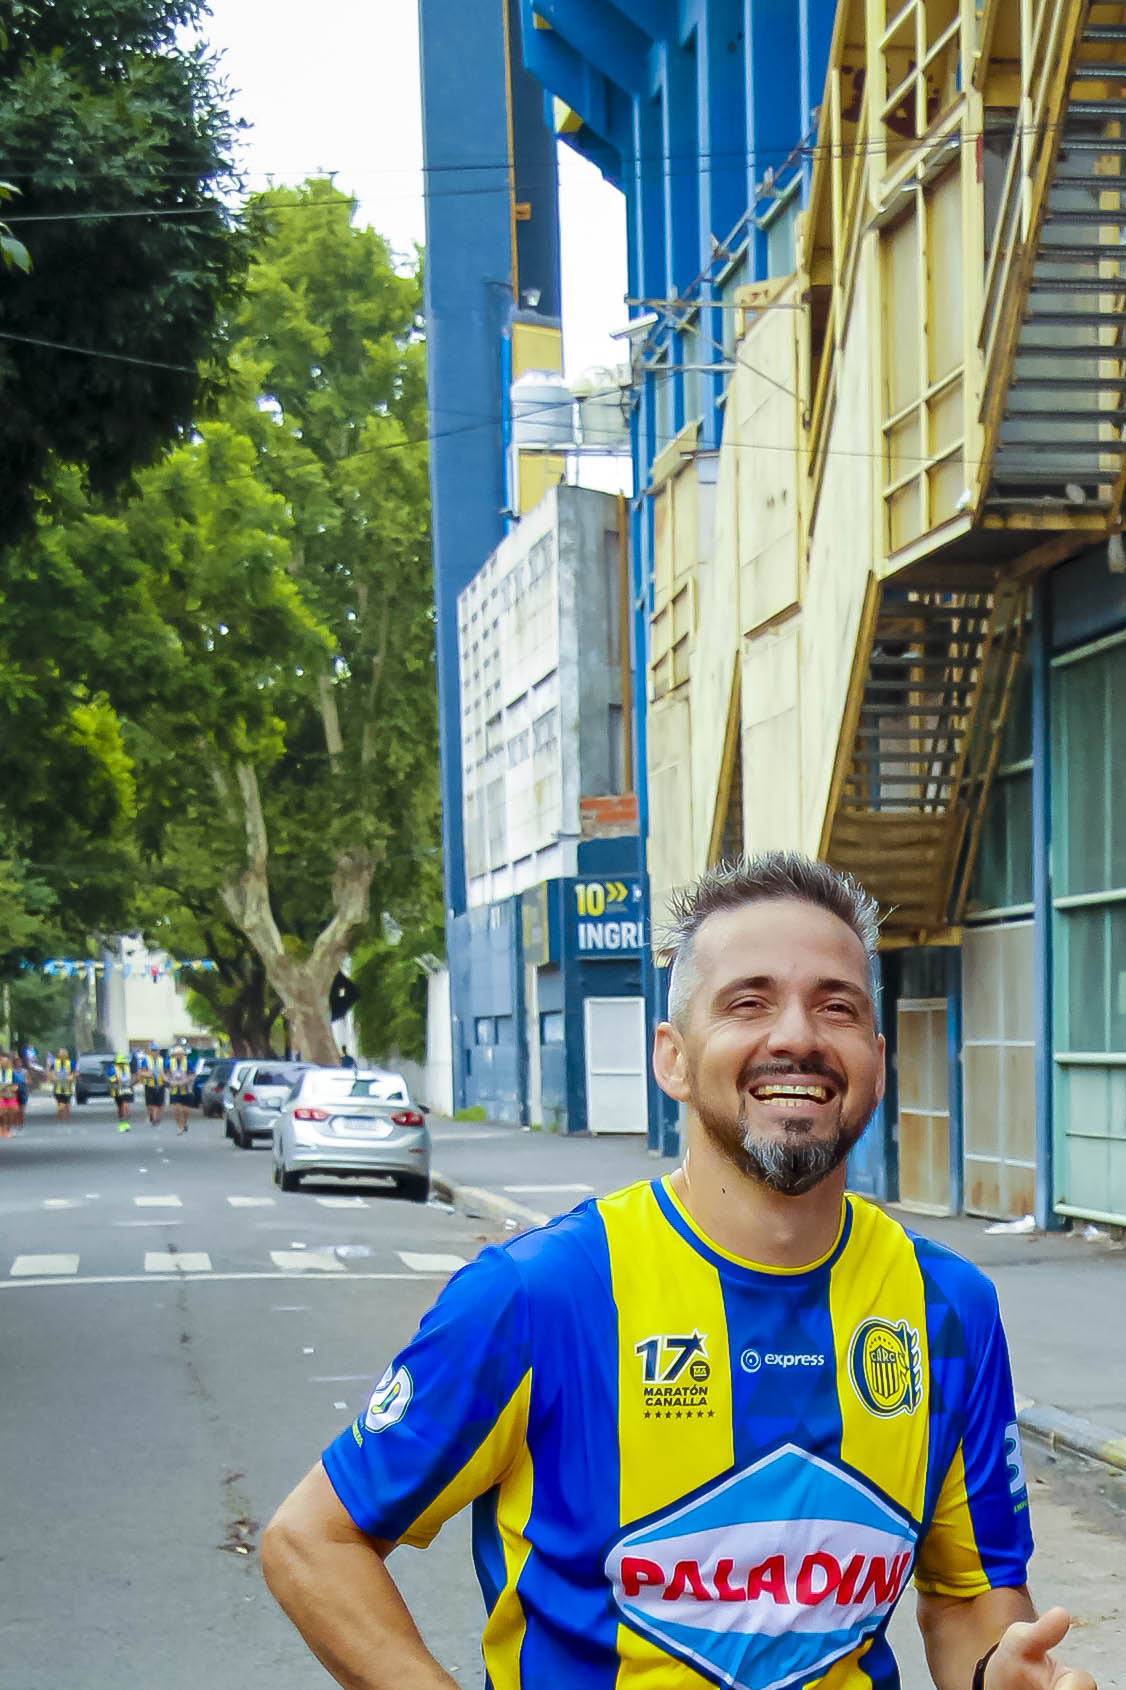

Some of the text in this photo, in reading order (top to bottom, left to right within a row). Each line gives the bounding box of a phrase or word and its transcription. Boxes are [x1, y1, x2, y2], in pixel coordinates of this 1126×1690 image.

[575, 882, 605, 917] 10
[634, 1328, 709, 1385] 17
[764, 1353, 825, 1368] express
[643, 1384, 708, 1397] MARATÓN
[645, 1397, 708, 1407] CANALLA
